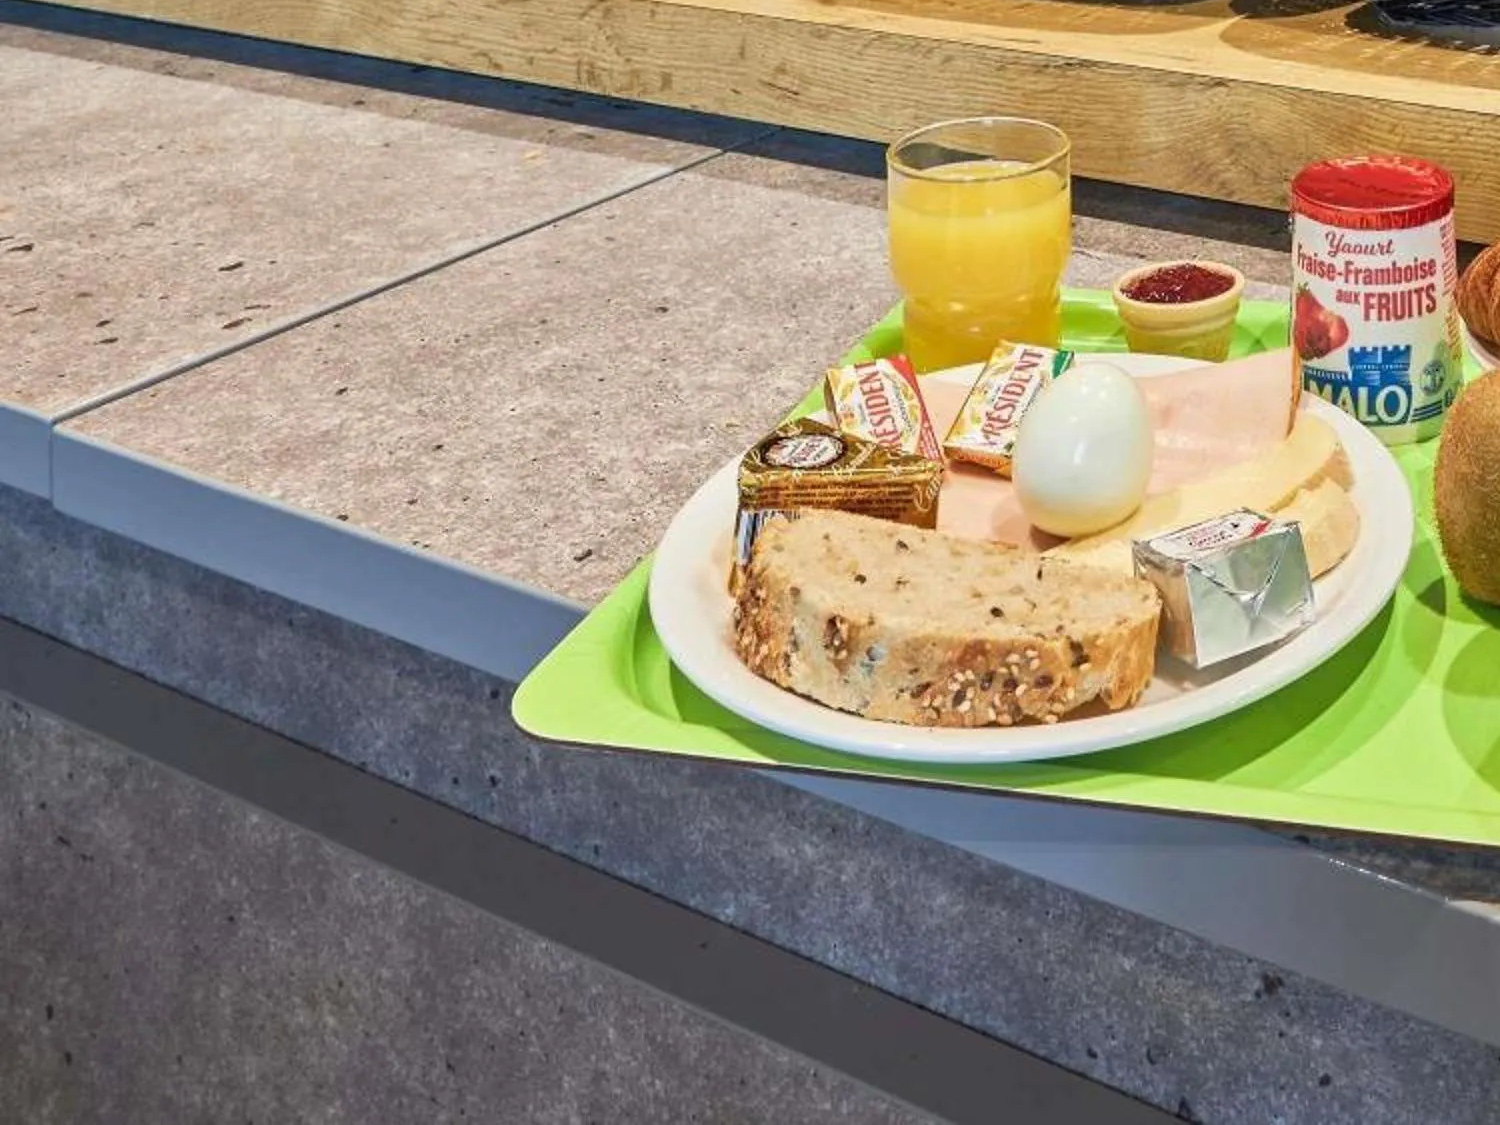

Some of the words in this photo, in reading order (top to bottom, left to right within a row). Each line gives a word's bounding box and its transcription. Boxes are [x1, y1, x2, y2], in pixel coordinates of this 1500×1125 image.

[1325, 230, 1396, 257] Yaourt
[1335, 288, 1361, 305] aux
[1363, 282, 1437, 322] FRUITS
[1308, 377, 1409, 424] MALO
